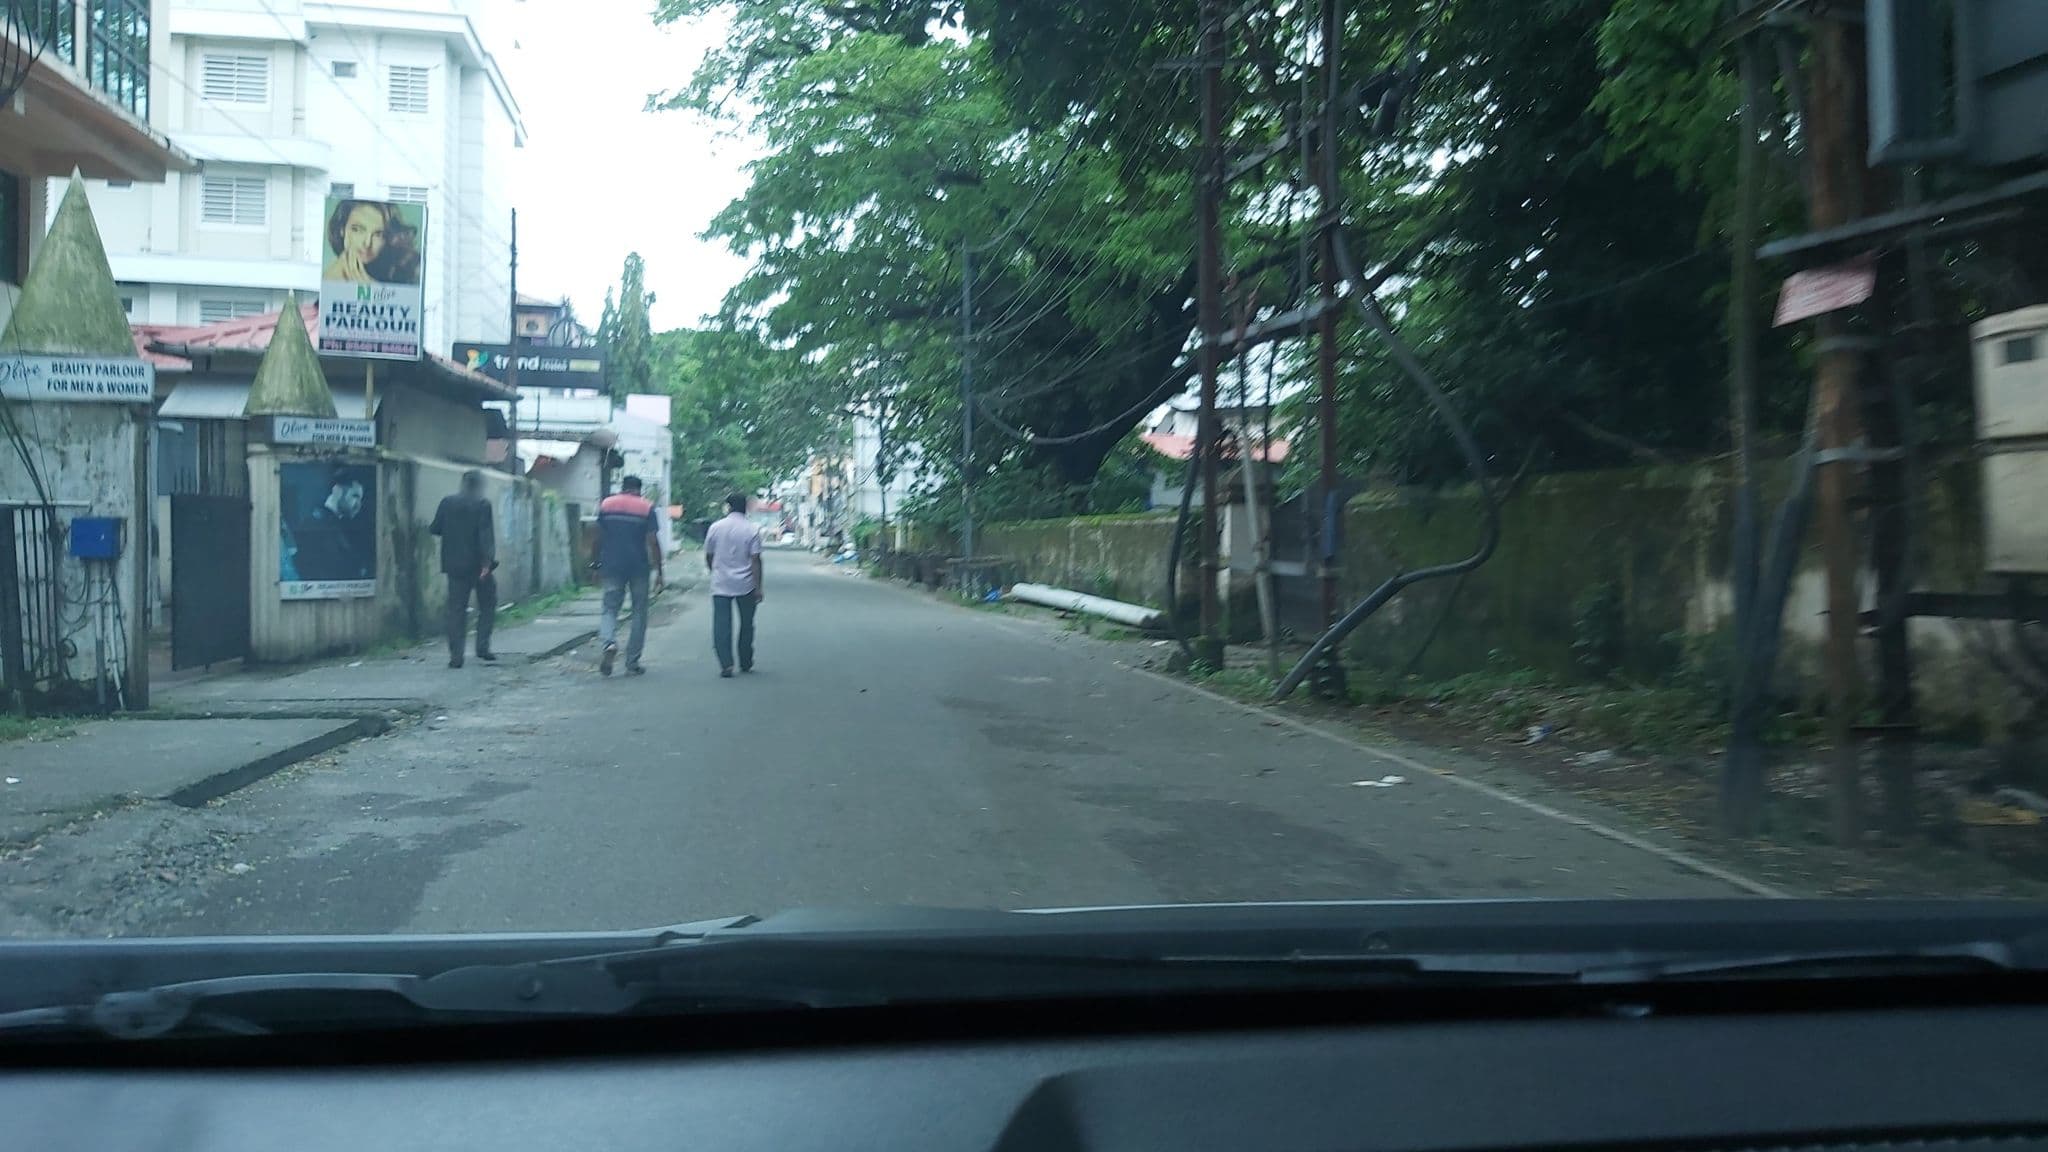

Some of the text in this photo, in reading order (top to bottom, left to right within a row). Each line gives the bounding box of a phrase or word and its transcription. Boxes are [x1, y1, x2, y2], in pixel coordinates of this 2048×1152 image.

[332, 302, 410, 319] BEAUTY
[325, 314, 417, 333] PARLOUR
[52, 362, 145, 378] BEAUTY PARLOUR
[494, 354, 540, 371] trnd
[47, 379, 149, 395] FOR MEN & WOMEN
